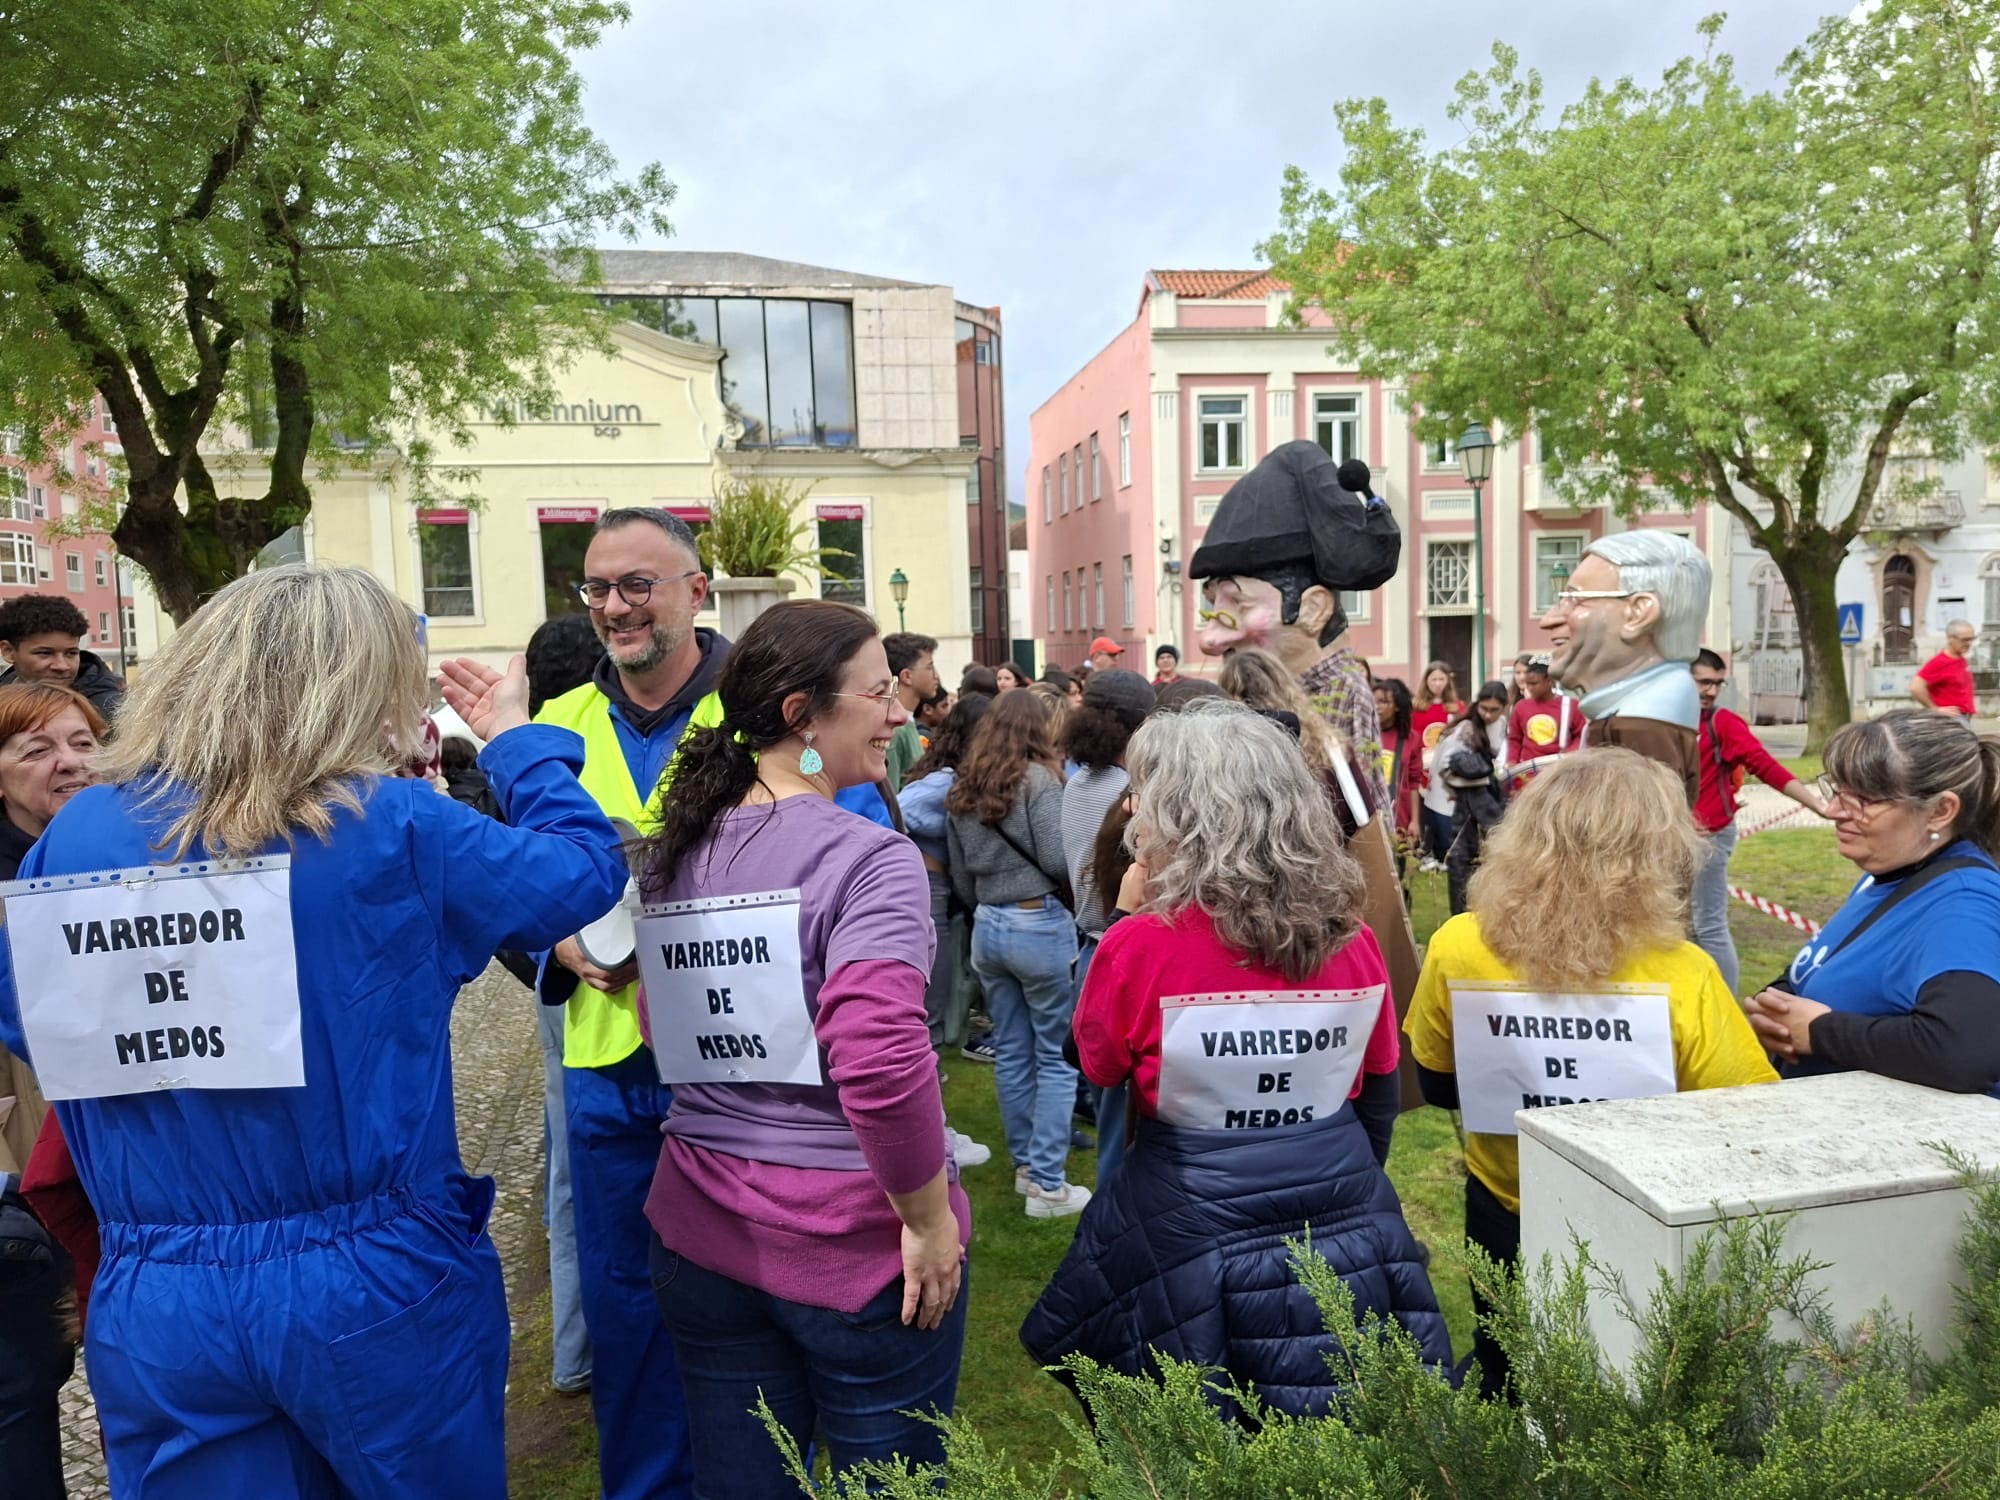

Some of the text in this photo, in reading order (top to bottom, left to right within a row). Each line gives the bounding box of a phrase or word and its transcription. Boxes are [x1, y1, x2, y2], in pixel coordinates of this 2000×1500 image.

[594, 424, 621, 439] bcp
[62, 908, 246, 955] VARREDOR
[661, 936, 770, 970] VARREDOR
[144, 970, 190, 1005] DE
[706, 988, 735, 1015] DE
[1200, 1026, 1348, 1057] VARREDOR
[1487, 1014, 1633, 1042] VARREDOR
[114, 1026, 226, 1065] MEDOS
[696, 1034, 768, 1060] MEDOS
[1545, 1056, 1579, 1080] DE
[1257, 1072, 1292, 1094] DE
[1224, 1105, 1314, 1129] MEDOS
